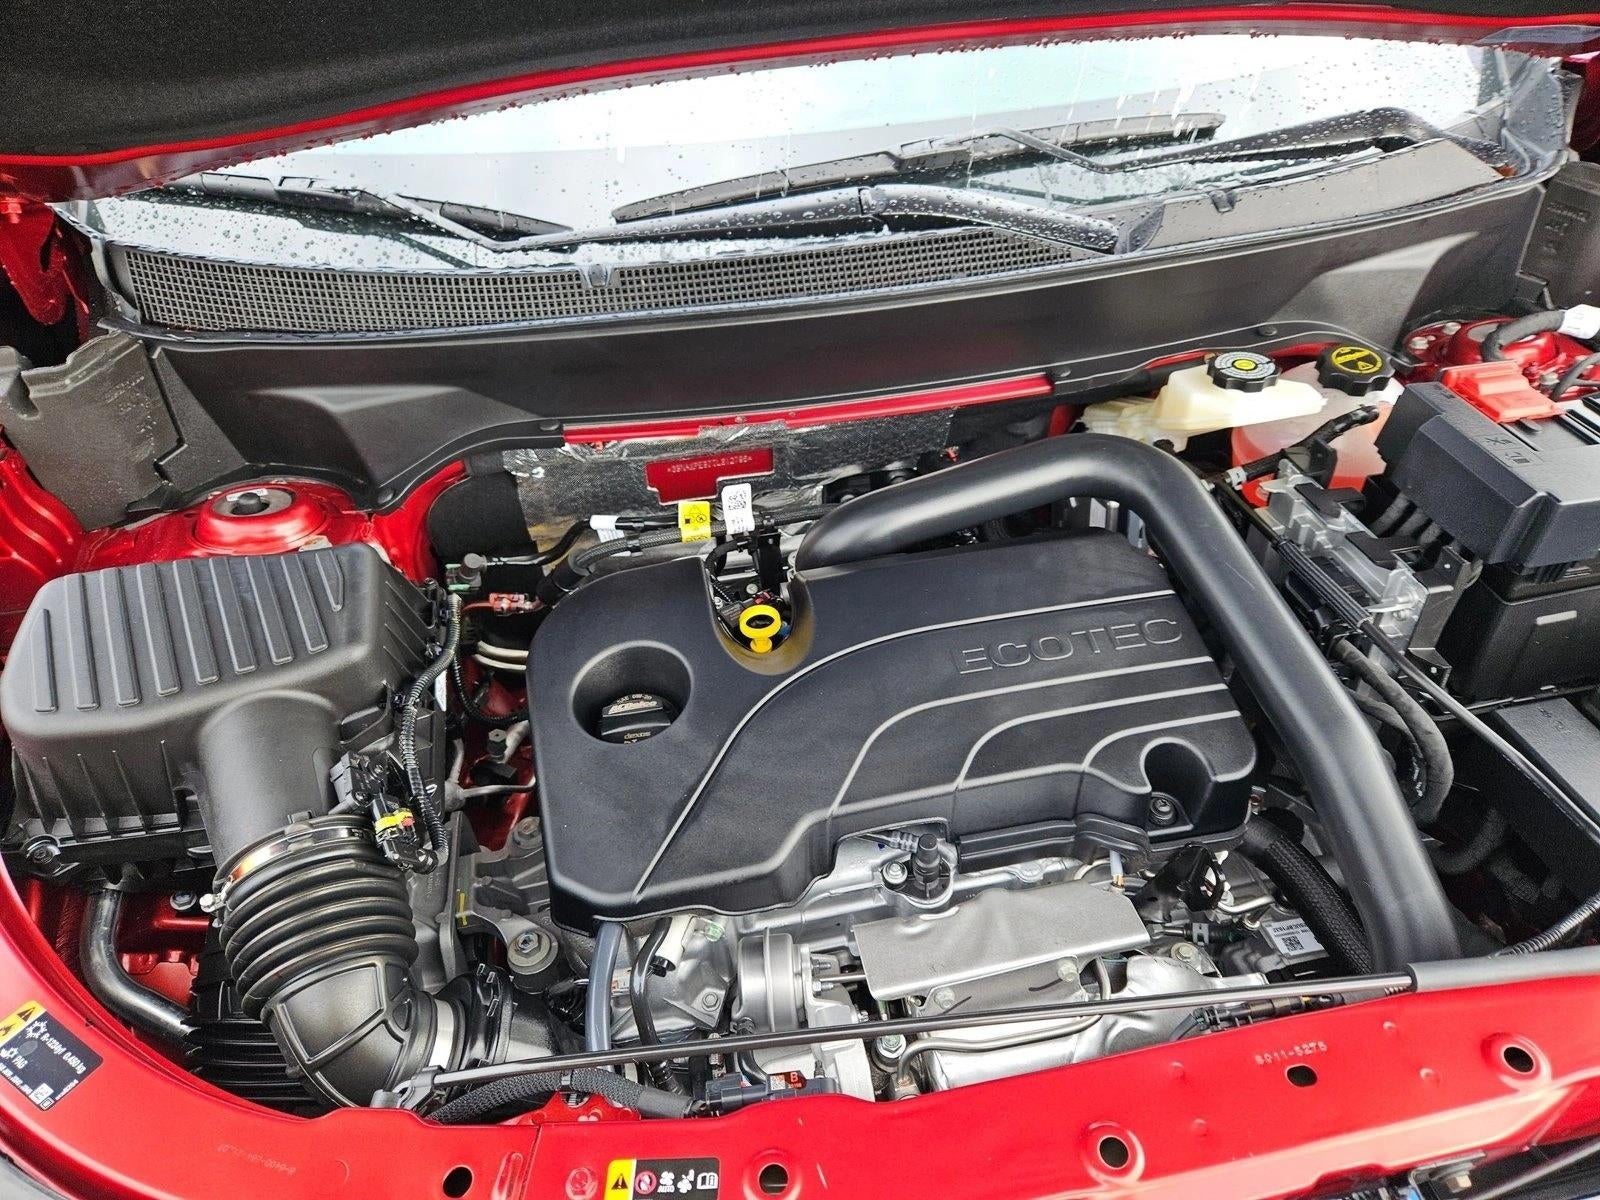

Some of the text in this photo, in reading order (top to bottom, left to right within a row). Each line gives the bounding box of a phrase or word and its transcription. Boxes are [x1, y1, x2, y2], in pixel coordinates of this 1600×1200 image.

[955, 618, 1183, 675] ECOTEC
[12, 1055, 28, 1070] PAG
[789, 1071, 799, 1083] B
[656, 1184, 676, 1194] AUTO
